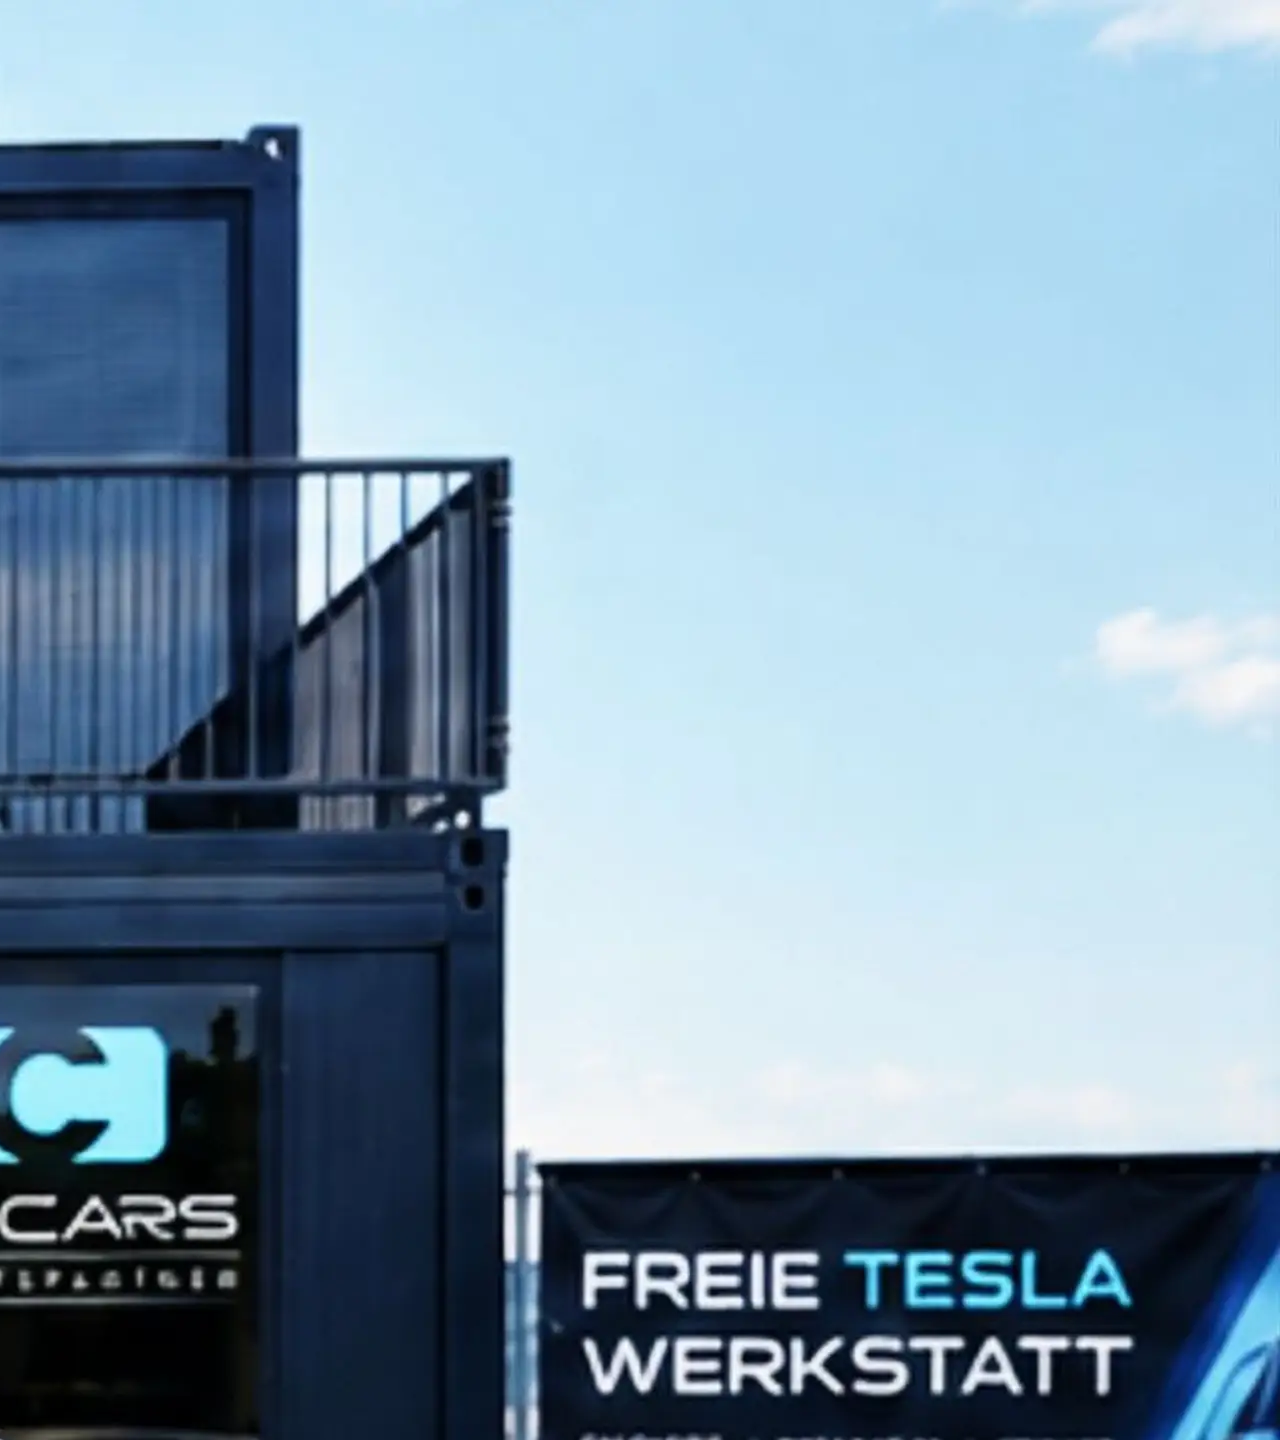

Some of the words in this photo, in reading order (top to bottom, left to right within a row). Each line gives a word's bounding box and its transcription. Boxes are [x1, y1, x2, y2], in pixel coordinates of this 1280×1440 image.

[582, 1251, 820, 1309] FREIE
[843, 1250, 1132, 1309] TESLA
[582, 1335, 1134, 1396] WERKSTATT
